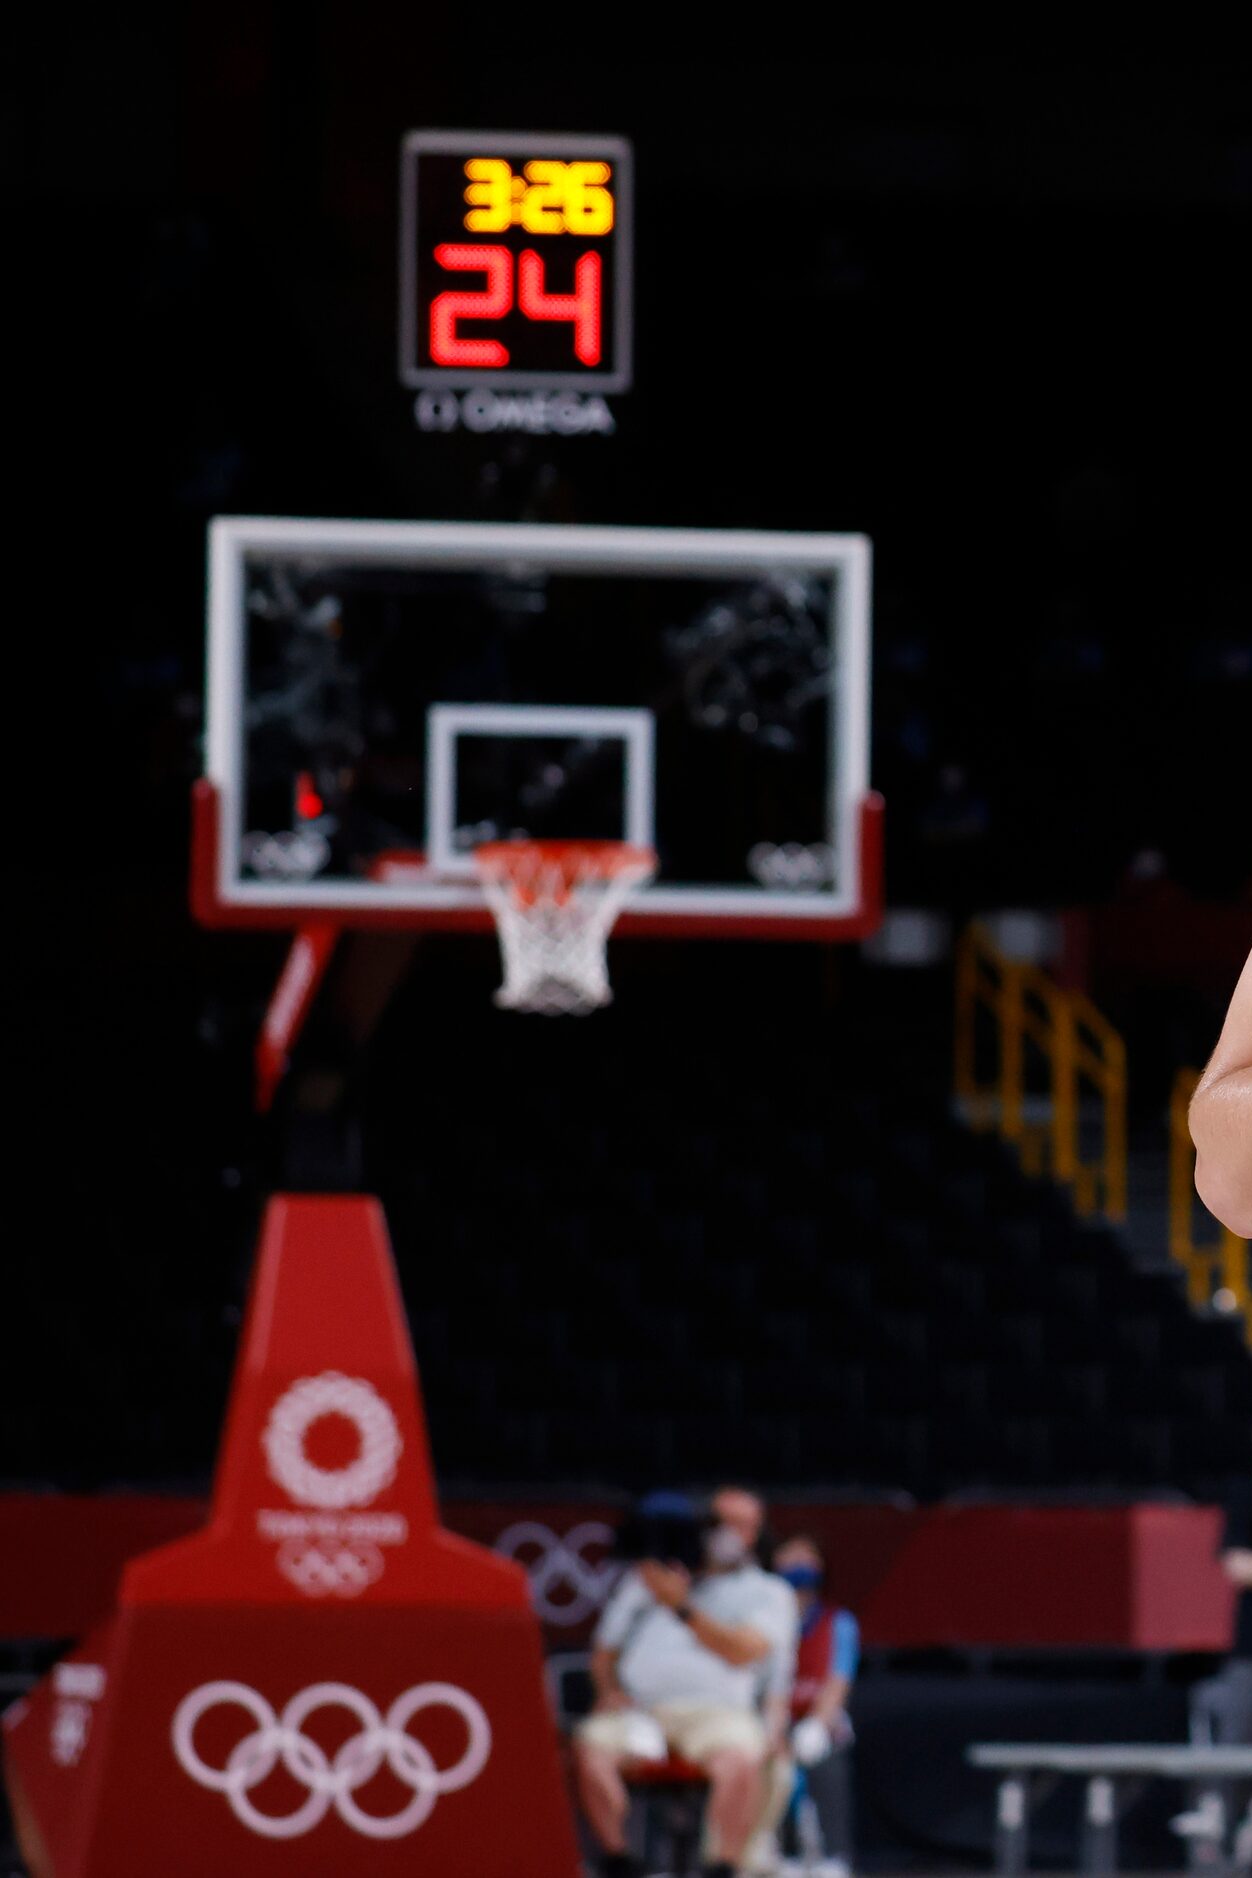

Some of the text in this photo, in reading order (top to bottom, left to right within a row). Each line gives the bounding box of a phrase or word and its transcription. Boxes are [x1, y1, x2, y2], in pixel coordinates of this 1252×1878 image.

[463, 158, 614, 235] 3:26
[429, 243, 602, 367] 24
[462, 391, 615, 435] OMEGA
